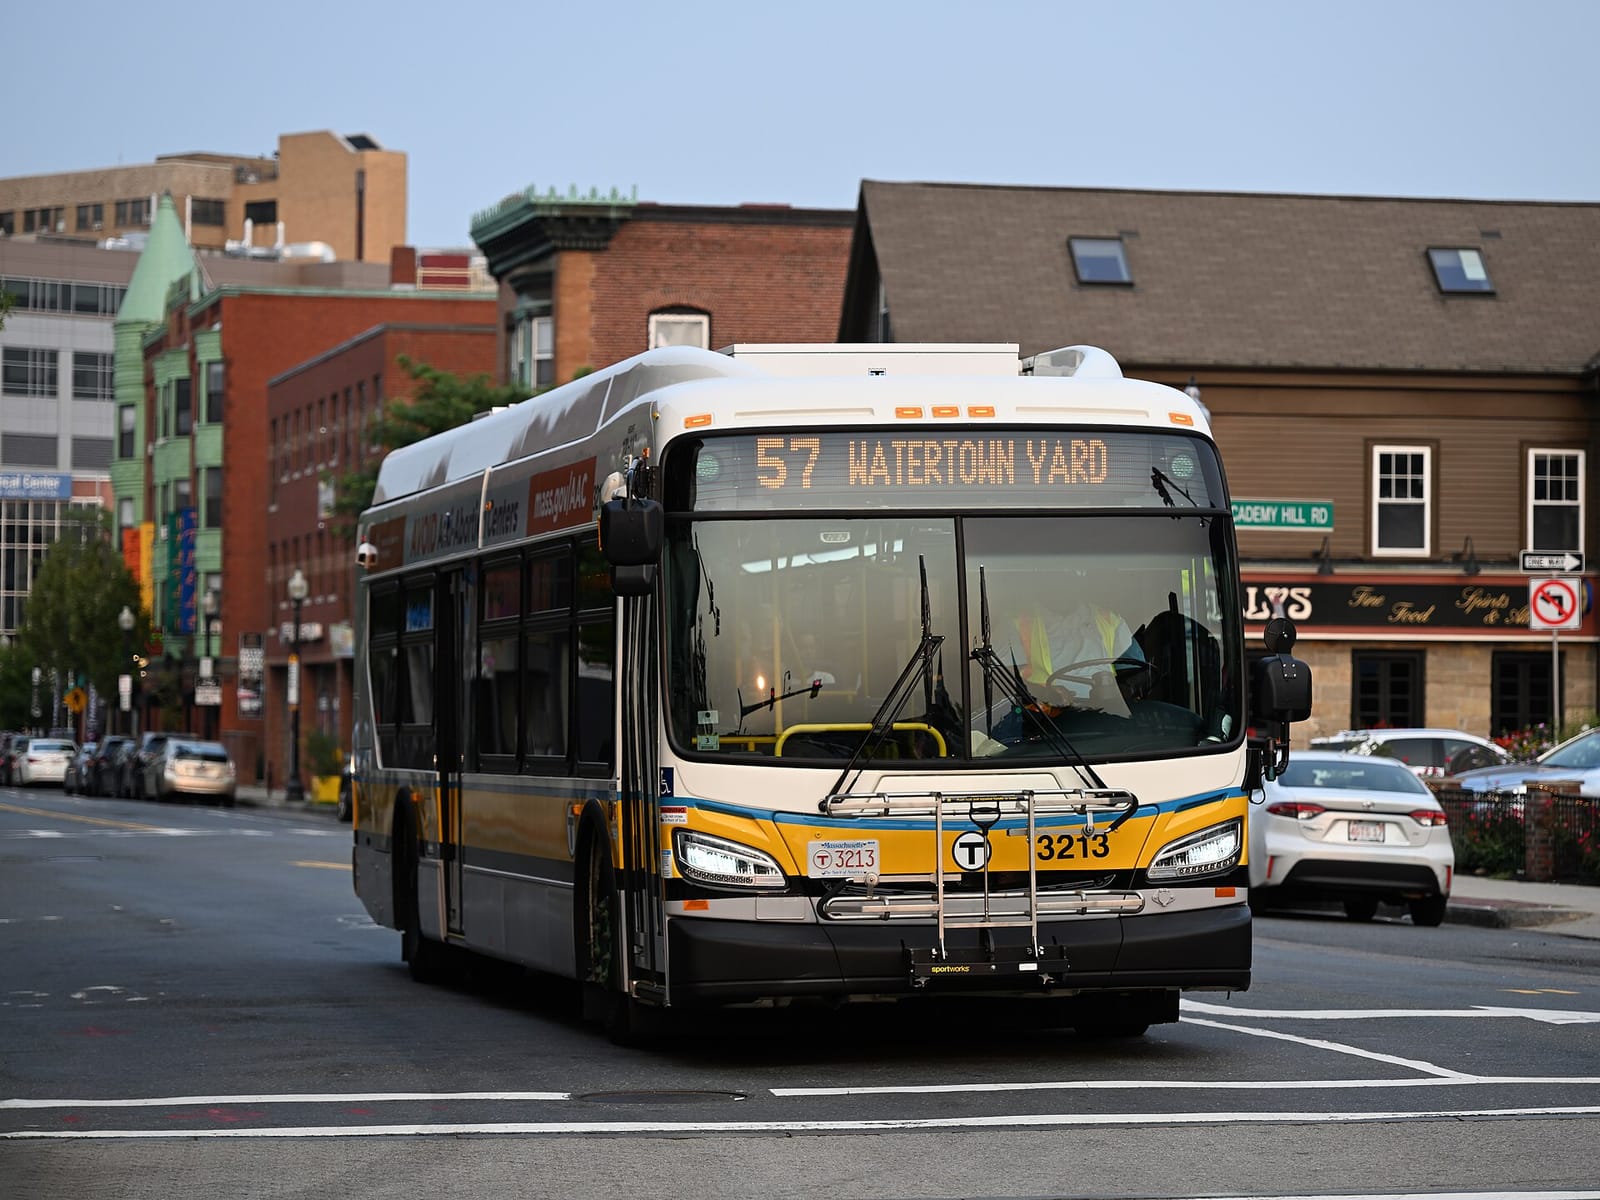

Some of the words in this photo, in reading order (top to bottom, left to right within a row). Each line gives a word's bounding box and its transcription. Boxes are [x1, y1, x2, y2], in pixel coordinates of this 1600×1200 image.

[757, 437, 821, 489] 57
[849, 439, 1014, 486] WATERTOWN
[1026, 439, 1108, 484] YARD
[534, 471, 588, 523] mass.gov/AAC
[486, 499, 519, 537] Centers
[1281, 507, 1306, 524] HILL
[1311, 507, 1328, 524] RD
[1243, 586, 1312, 621] LYS
[1348, 586, 1386, 608] Fine
[1455, 586, 1510, 615] Spirits
[1388, 601, 1435, 623] Food
[817, 855, 829, 865] T
[835, 850, 875, 868] 3213
[959, 842, 985, 865] T
[1037, 834, 1110, 861] 3213
[931, 965, 970, 974] sportworks
